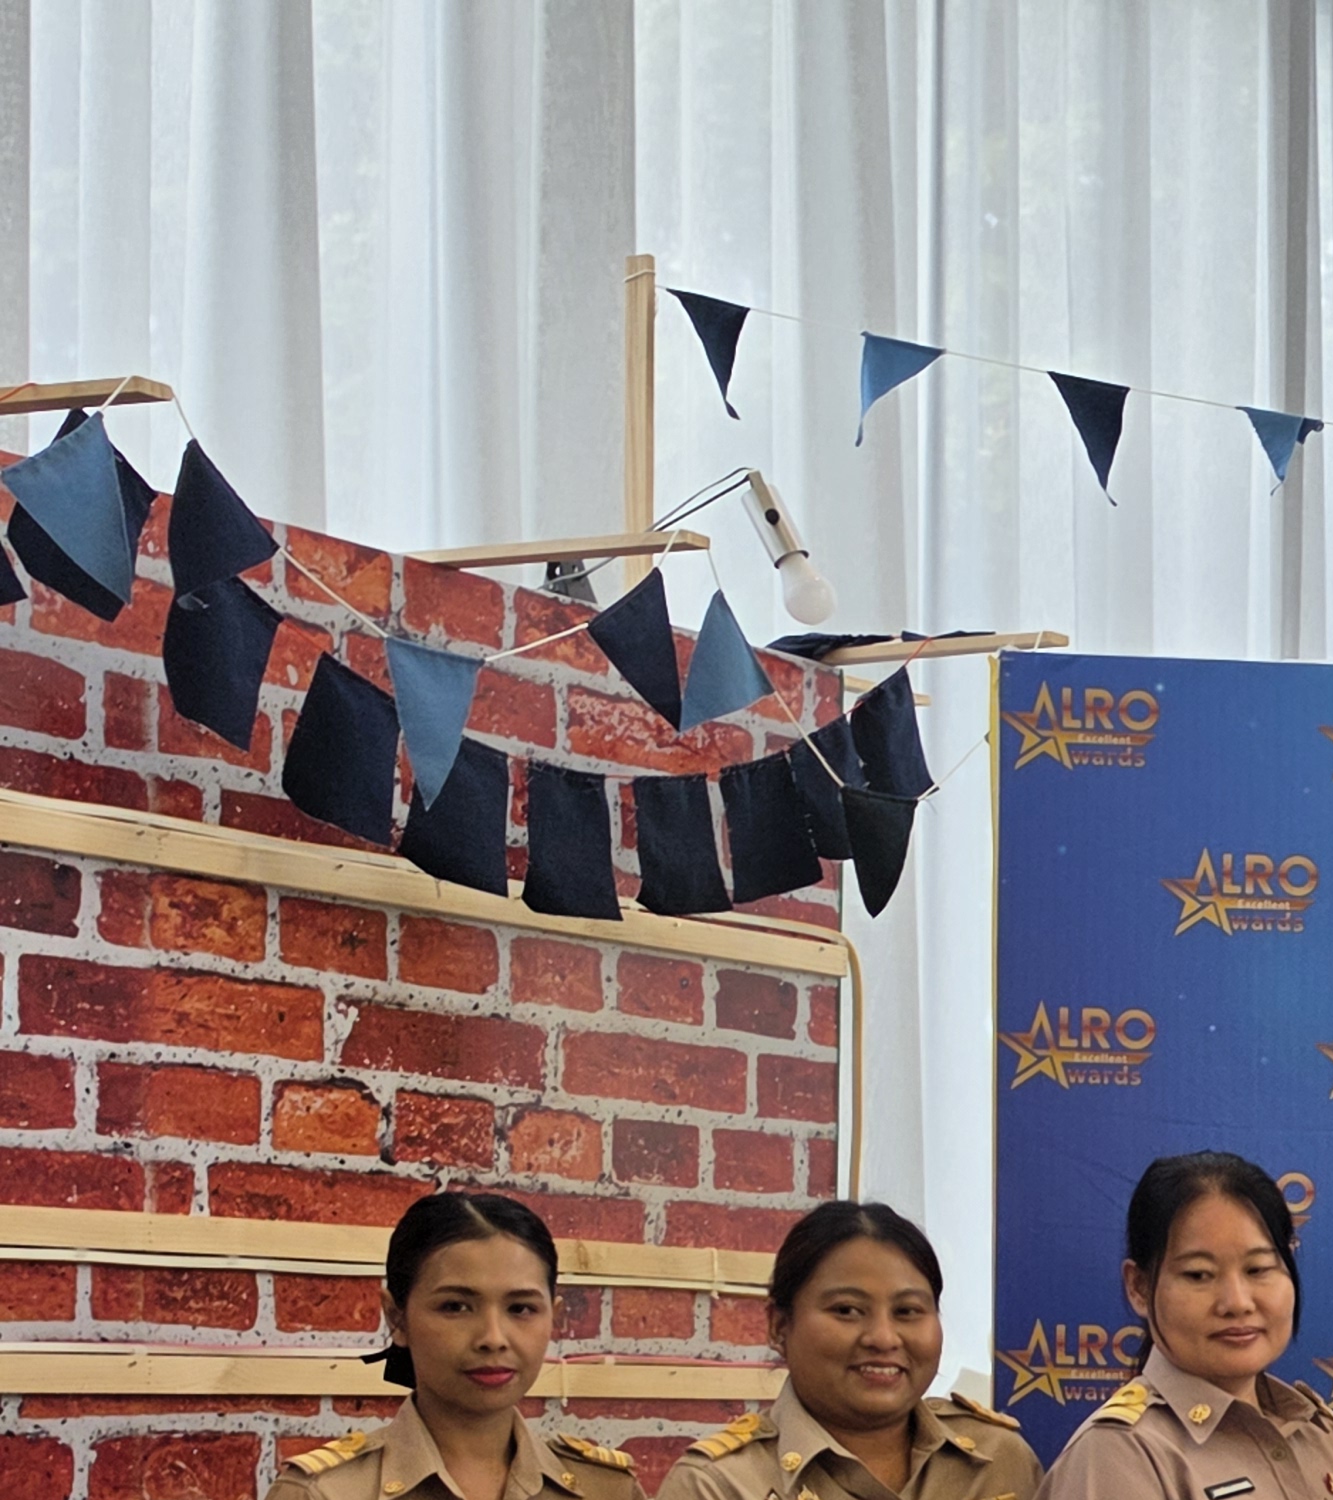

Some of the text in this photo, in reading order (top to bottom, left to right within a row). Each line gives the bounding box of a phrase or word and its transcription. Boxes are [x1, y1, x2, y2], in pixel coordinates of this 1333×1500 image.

[1004, 681, 1160, 733] ALRO
[1077, 733, 1131, 745] Excellent
[1165, 848, 1319, 897] ALRO
[1236, 900, 1291, 911] Excellent
[1002, 1001, 1156, 1050] ALRO
[1073, 1053, 1128, 1064] Excellent
[1070, 1369, 1125, 1380] Excellent
